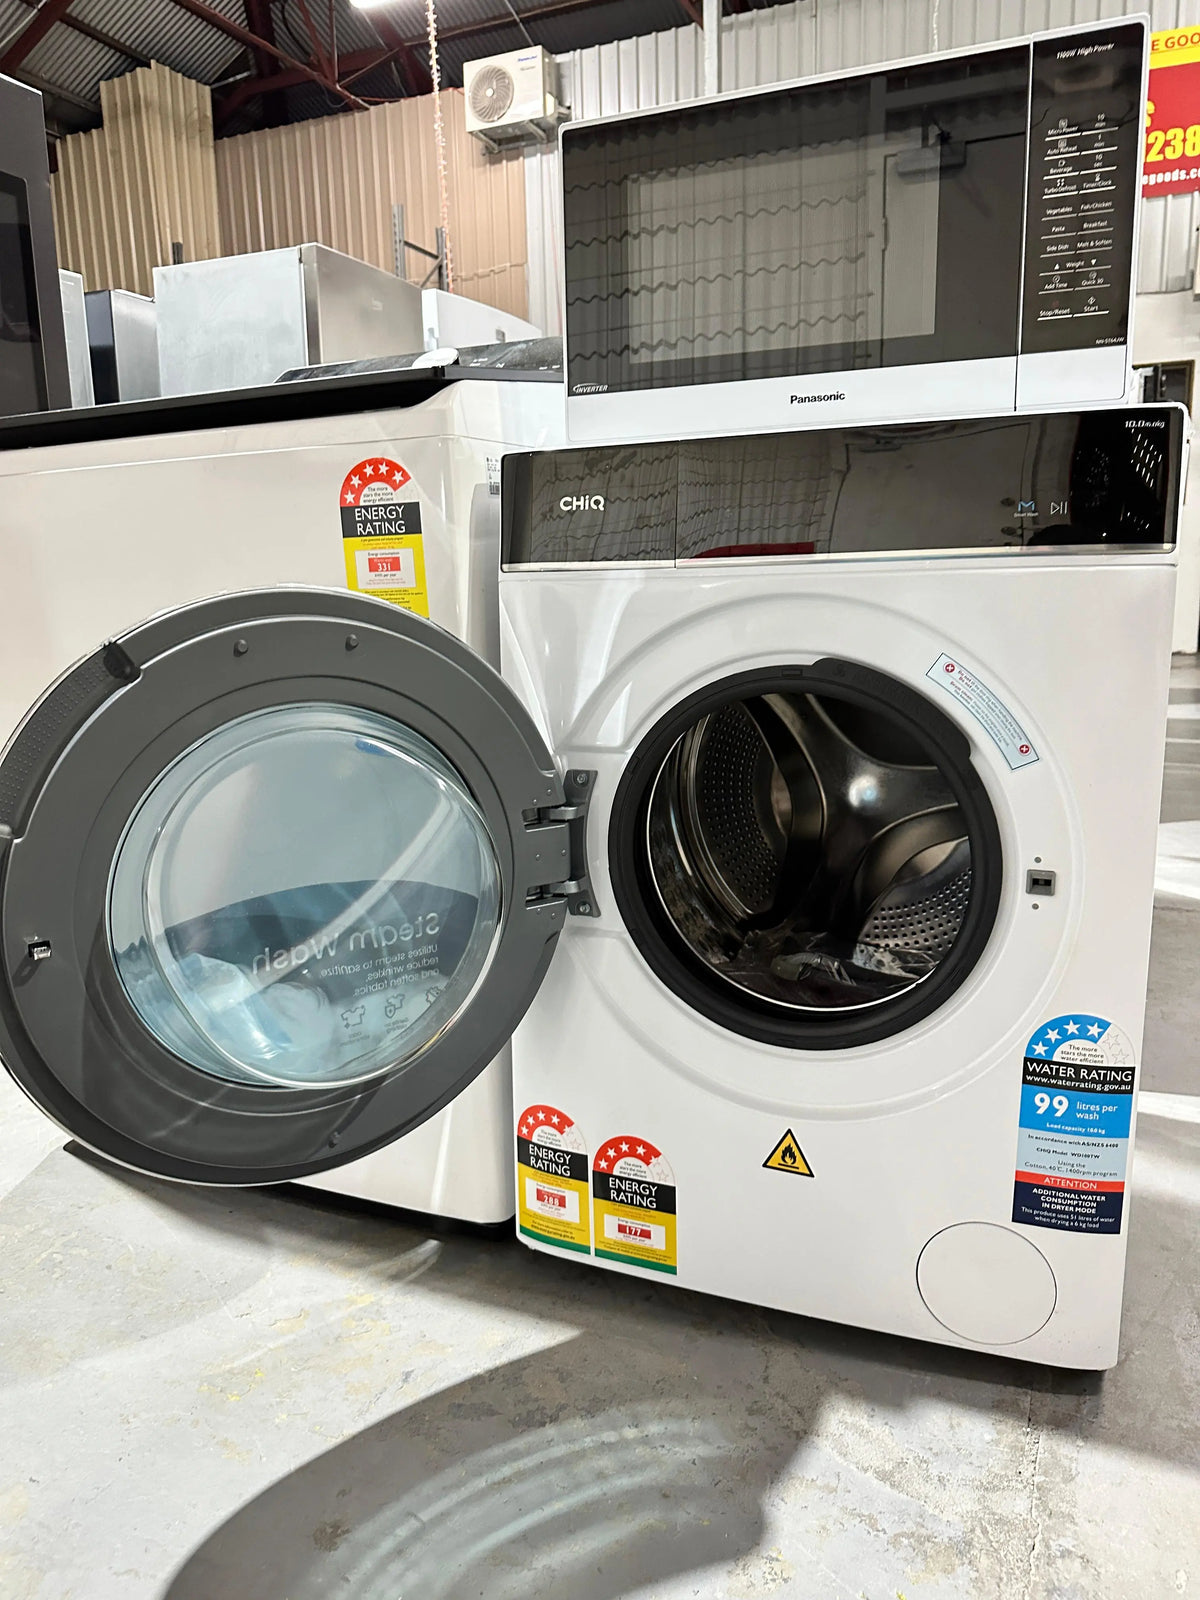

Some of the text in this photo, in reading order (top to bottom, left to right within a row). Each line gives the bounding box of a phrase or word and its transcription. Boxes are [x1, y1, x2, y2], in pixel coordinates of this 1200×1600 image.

[1077, 45, 1093, 56] High
[1094, 43, 1114, 52] Power
[1083, 220, 1108, 229] Breakfast
[1066, 260, 1084, 268] Weight
[576, 384, 608, 394] INVERTER
[790, 391, 846, 404] Panasonic
[560, 495, 605, 511] CHiQ
[355, 505, 404, 520] ENERGY
[357, 521, 406, 535] RATING
[378, 563, 391, 572] 331
[1027, 1061, 1132, 1081] WATER RATING
[1026, 1074, 1131, 1091] www.waterrating.gov.au
[1034, 1093, 1118, 1117] 99 litres per
[1076, 1112, 1099, 1120] wash
[1062, 1125, 1086, 1133] capacity
[1035, 1136, 1067, 1144] accordance
[529, 1144, 571, 1164] ENERGY
[530, 1156, 570, 1176] RATING
[609, 1177, 658, 1197] ENERGY
[1044, 1177, 1097, 1189] ATTENTION
[544, 1194, 559, 1206] 288
[611, 1190, 656, 1209] RATING
[1032, 1188, 1079, 1200] ADDITIONAL
[1041, 1196, 1097, 1207] CONSUMPTION
[1051, 1204, 1074, 1212] DRYER
[1051, 1218, 1069, 1226] drying
[626, 1226, 641, 1236] 177
